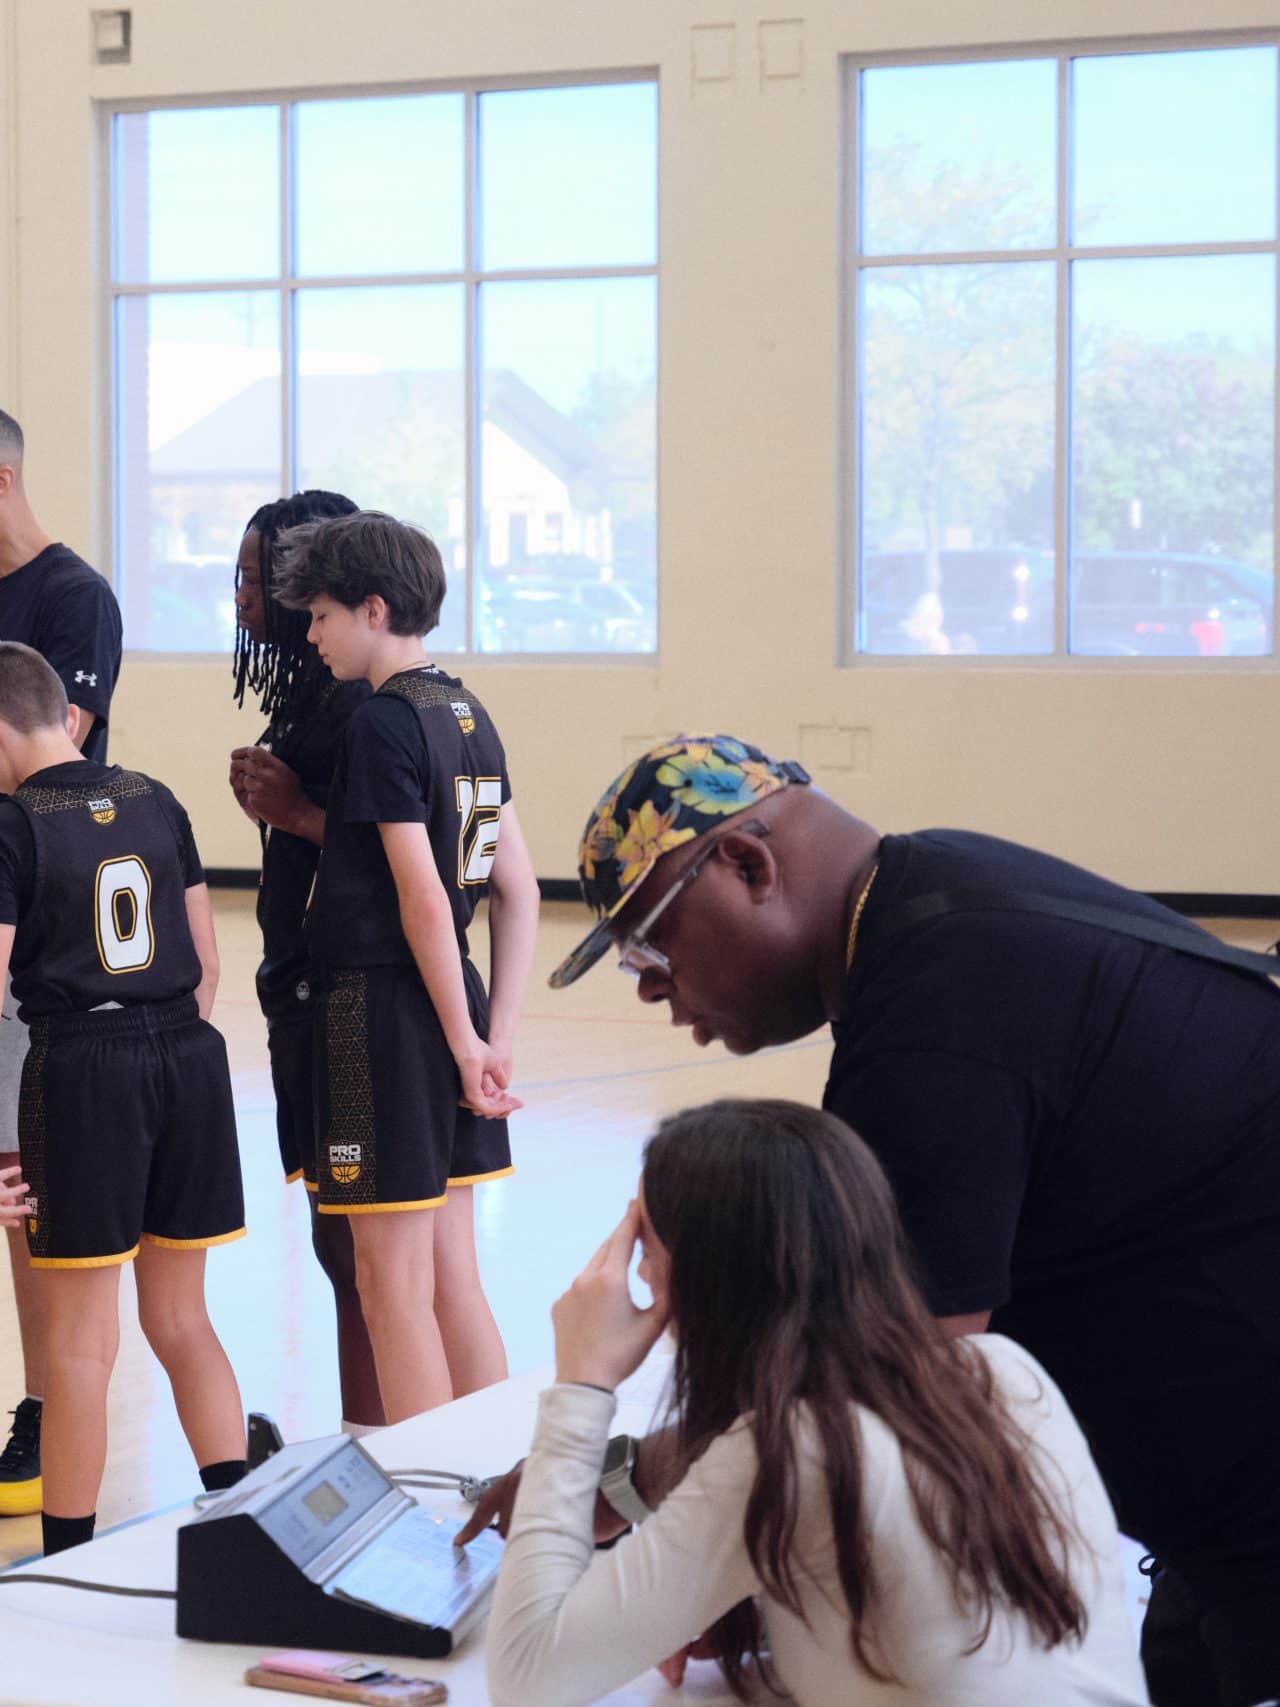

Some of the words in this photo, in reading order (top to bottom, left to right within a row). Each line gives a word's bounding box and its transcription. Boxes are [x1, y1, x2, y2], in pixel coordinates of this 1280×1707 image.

[454, 775, 502, 889] 12
[94, 854, 155, 975] 0
[329, 1144, 361, 1156] PRO
